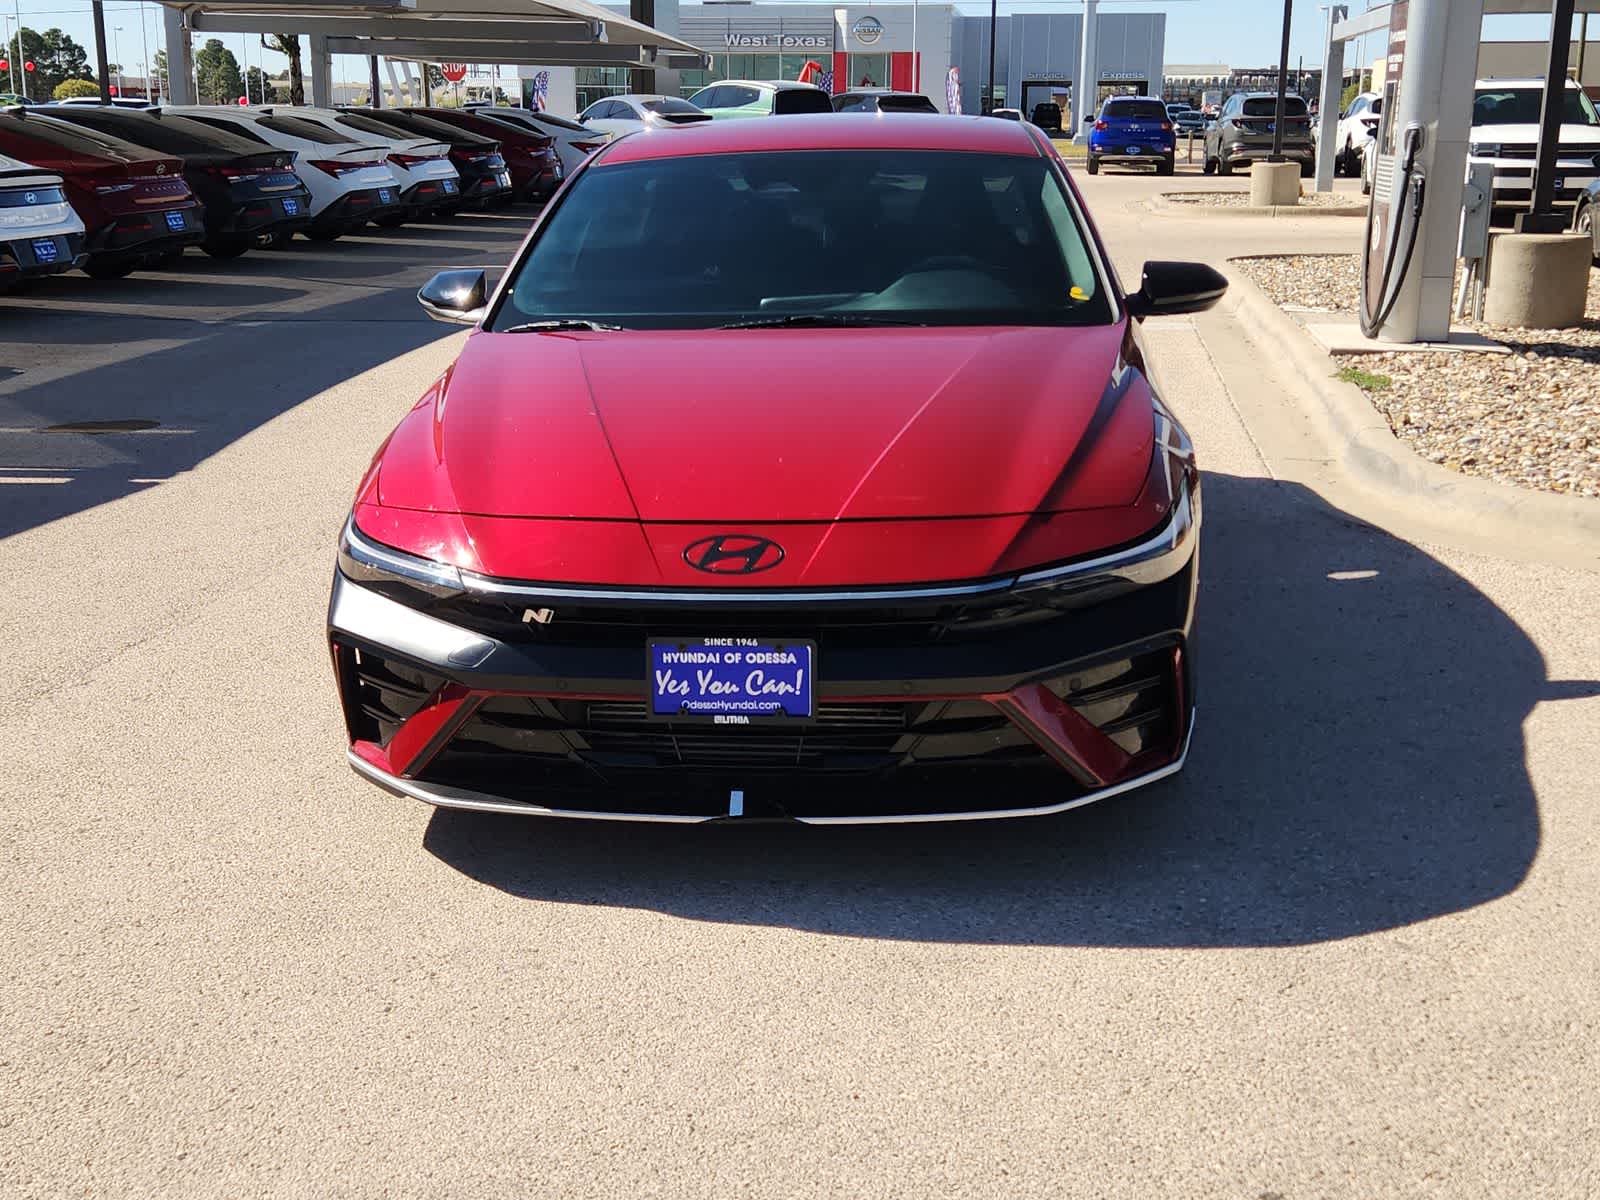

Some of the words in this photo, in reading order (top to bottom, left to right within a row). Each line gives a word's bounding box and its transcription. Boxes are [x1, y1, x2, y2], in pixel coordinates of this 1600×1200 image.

[724, 34, 767, 47] West
[773, 34, 826, 47] Texas
[443, 63, 465, 73] STOP
[1102, 71, 1145, 80] Express
[704, 638, 733, 647] SINCE
[736, 638, 758, 647] 1946
[662, 652, 720, 664] HYUNDAI
[724, 652, 742, 664] OF
[745, 652, 797, 664] ODESSA
[655, 669, 690, 696] Yes
[697, 669, 739, 696] You
[745, 669, 803, 696] Can!
[681, 700, 781, 711] OdessaHyundai.com
